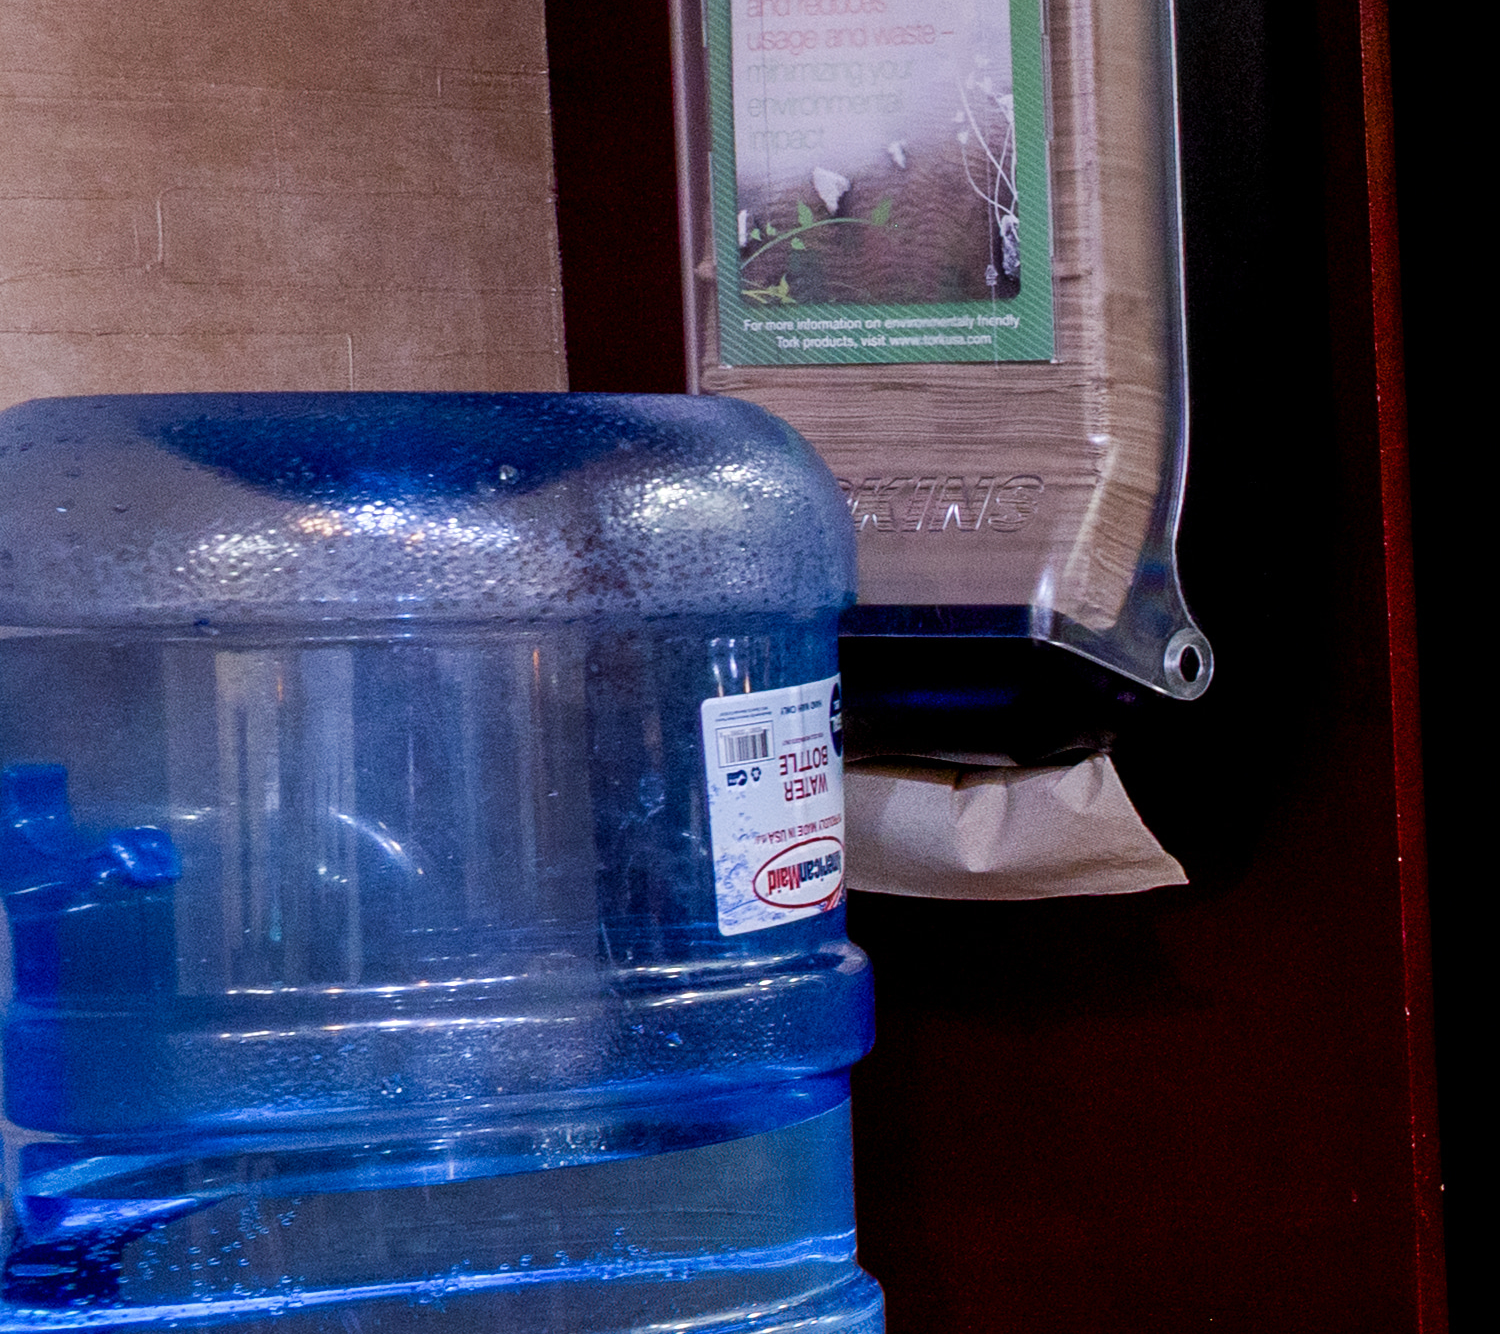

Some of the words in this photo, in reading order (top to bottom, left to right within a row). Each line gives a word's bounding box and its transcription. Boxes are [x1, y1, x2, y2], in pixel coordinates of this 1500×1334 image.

[743, 320, 765, 332] For
[796, 318, 862, 331] information
[865, 319, 882, 329] on
[977, 314, 1020, 329] friendly
[776, 336, 800, 349] Tork
[860, 335, 886, 347] visit
[840, 474, 1046, 533] KINS
[779, 745, 829, 777] BOTTLE
[783, 772, 829, 802] WATER
[769, 829, 787, 845] USA
[786, 826, 797, 840] IN
[797, 821, 818, 838] MADE
